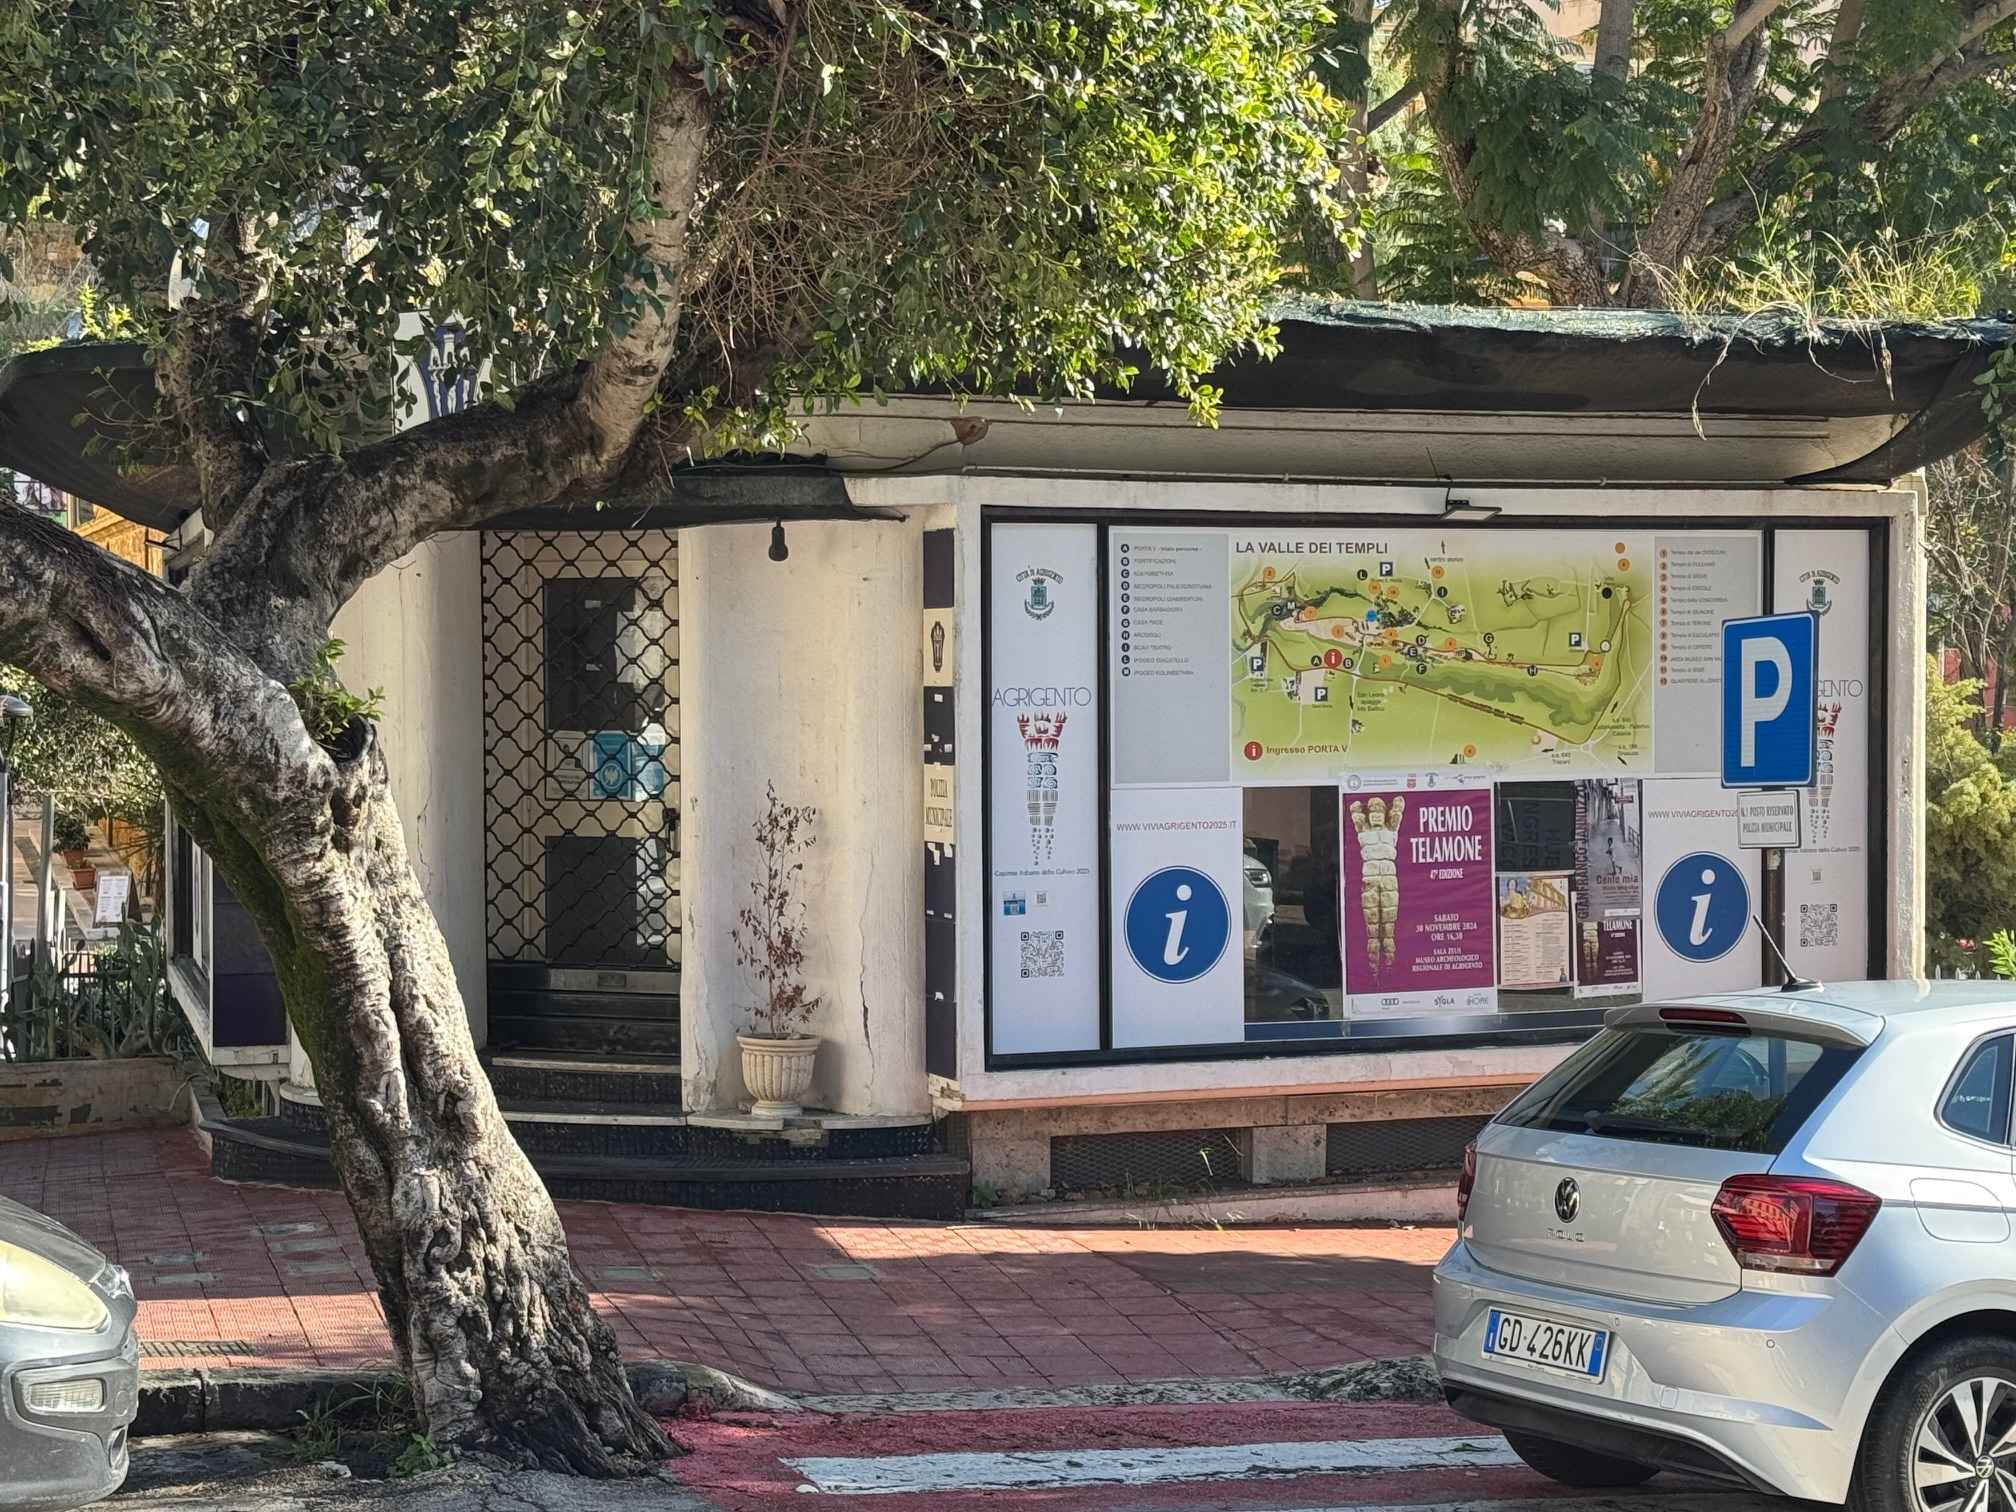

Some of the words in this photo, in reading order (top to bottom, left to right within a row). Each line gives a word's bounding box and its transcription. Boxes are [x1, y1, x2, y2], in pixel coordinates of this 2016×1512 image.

[1236, 542, 1254, 554] LA
[1258, 542, 1304, 554] VALLE
[1309, 542, 1332, 554] DEI
[1336, 542, 1388, 554] TEMPLI
[992, 687, 1092, 706] AGRIGENTO
[1740, 636, 1792, 768] P
[1266, 746, 1306, 755] Ingresso
[1308, 745, 1341, 753] PORTA
[1342, 745, 1349, 753] V
[1750, 806, 1766, 817] POSTO
[1766, 805, 1794, 817] RISERVATO
[1419, 805, 1473, 833] PREMIO
[1743, 822, 1760, 833] POLIZIA
[1761, 821, 1792, 832] MUNICIPALE
[1410, 835, 1482, 864] TELAMONE
[1439, 868, 1464, 879] EDIZIONE
[1623, 873, 1639, 883] mia
[1576, 847, 1590, 919] GIANFRANCO
[1434, 913, 1459, 921] SABATO
[1425, 923, 1460, 931] NOVEMBRE
[1462, 922, 1477, 930] 2024
[1604, 920, 1632, 931] TELAMONE
[1431, 933, 1444, 941] ORE
[1437, 954, 1479, 963] ARCHEOLOGICO
[1412, 963, 1443, 972] REGIONALE
[1452, 962, 1483, 970] AGRIGENTO
[1498, 1317, 1523, 1352] GD
[1526, 1324, 1592, 1369] 426KK
